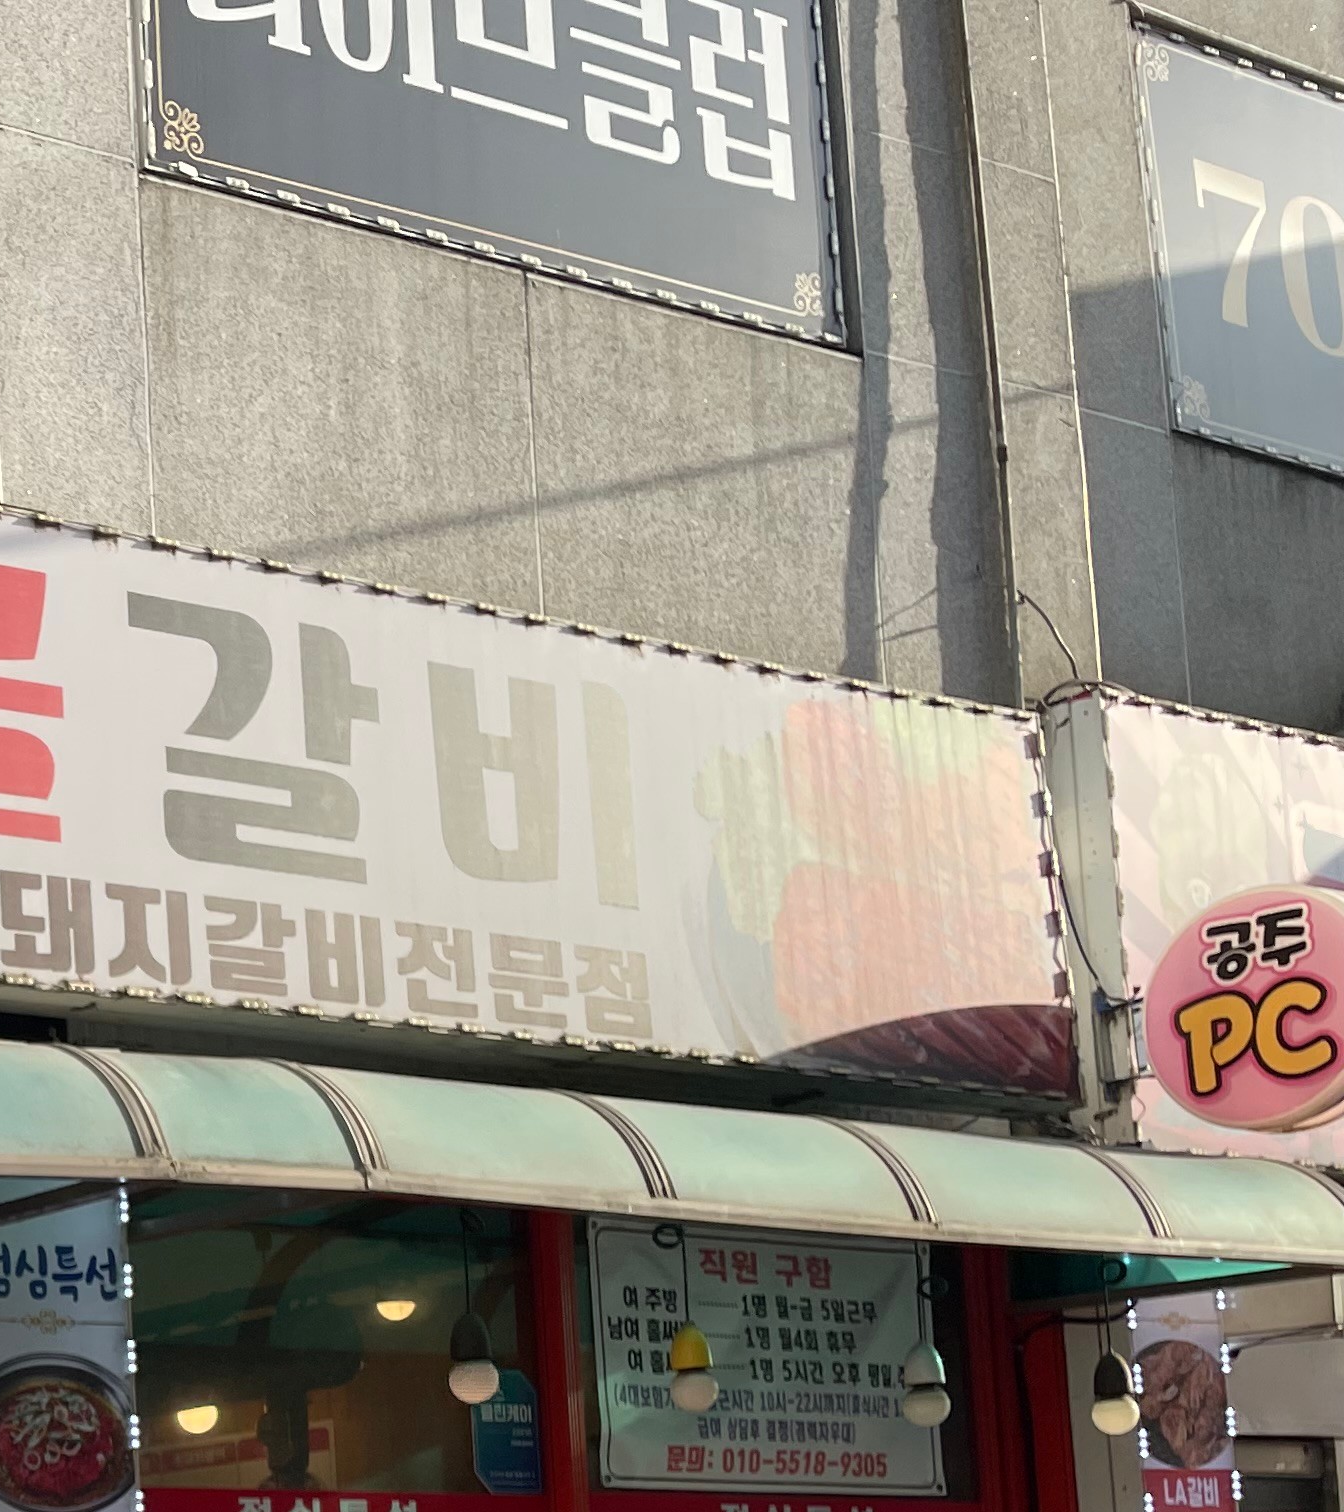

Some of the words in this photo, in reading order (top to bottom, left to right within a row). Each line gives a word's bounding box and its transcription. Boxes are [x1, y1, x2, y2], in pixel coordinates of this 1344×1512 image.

[0, 869, 653, 1041] 돼지갈비전문점
[1176, 978, 1337, 1097] PC
[698, 1248, 759, 1285] 직원
[775, 1254, 832, 1290] 구함
[722, 1448, 887, 1477] 010-5518-9305
[1163, 1476, 1220, 1508] LA갈비
